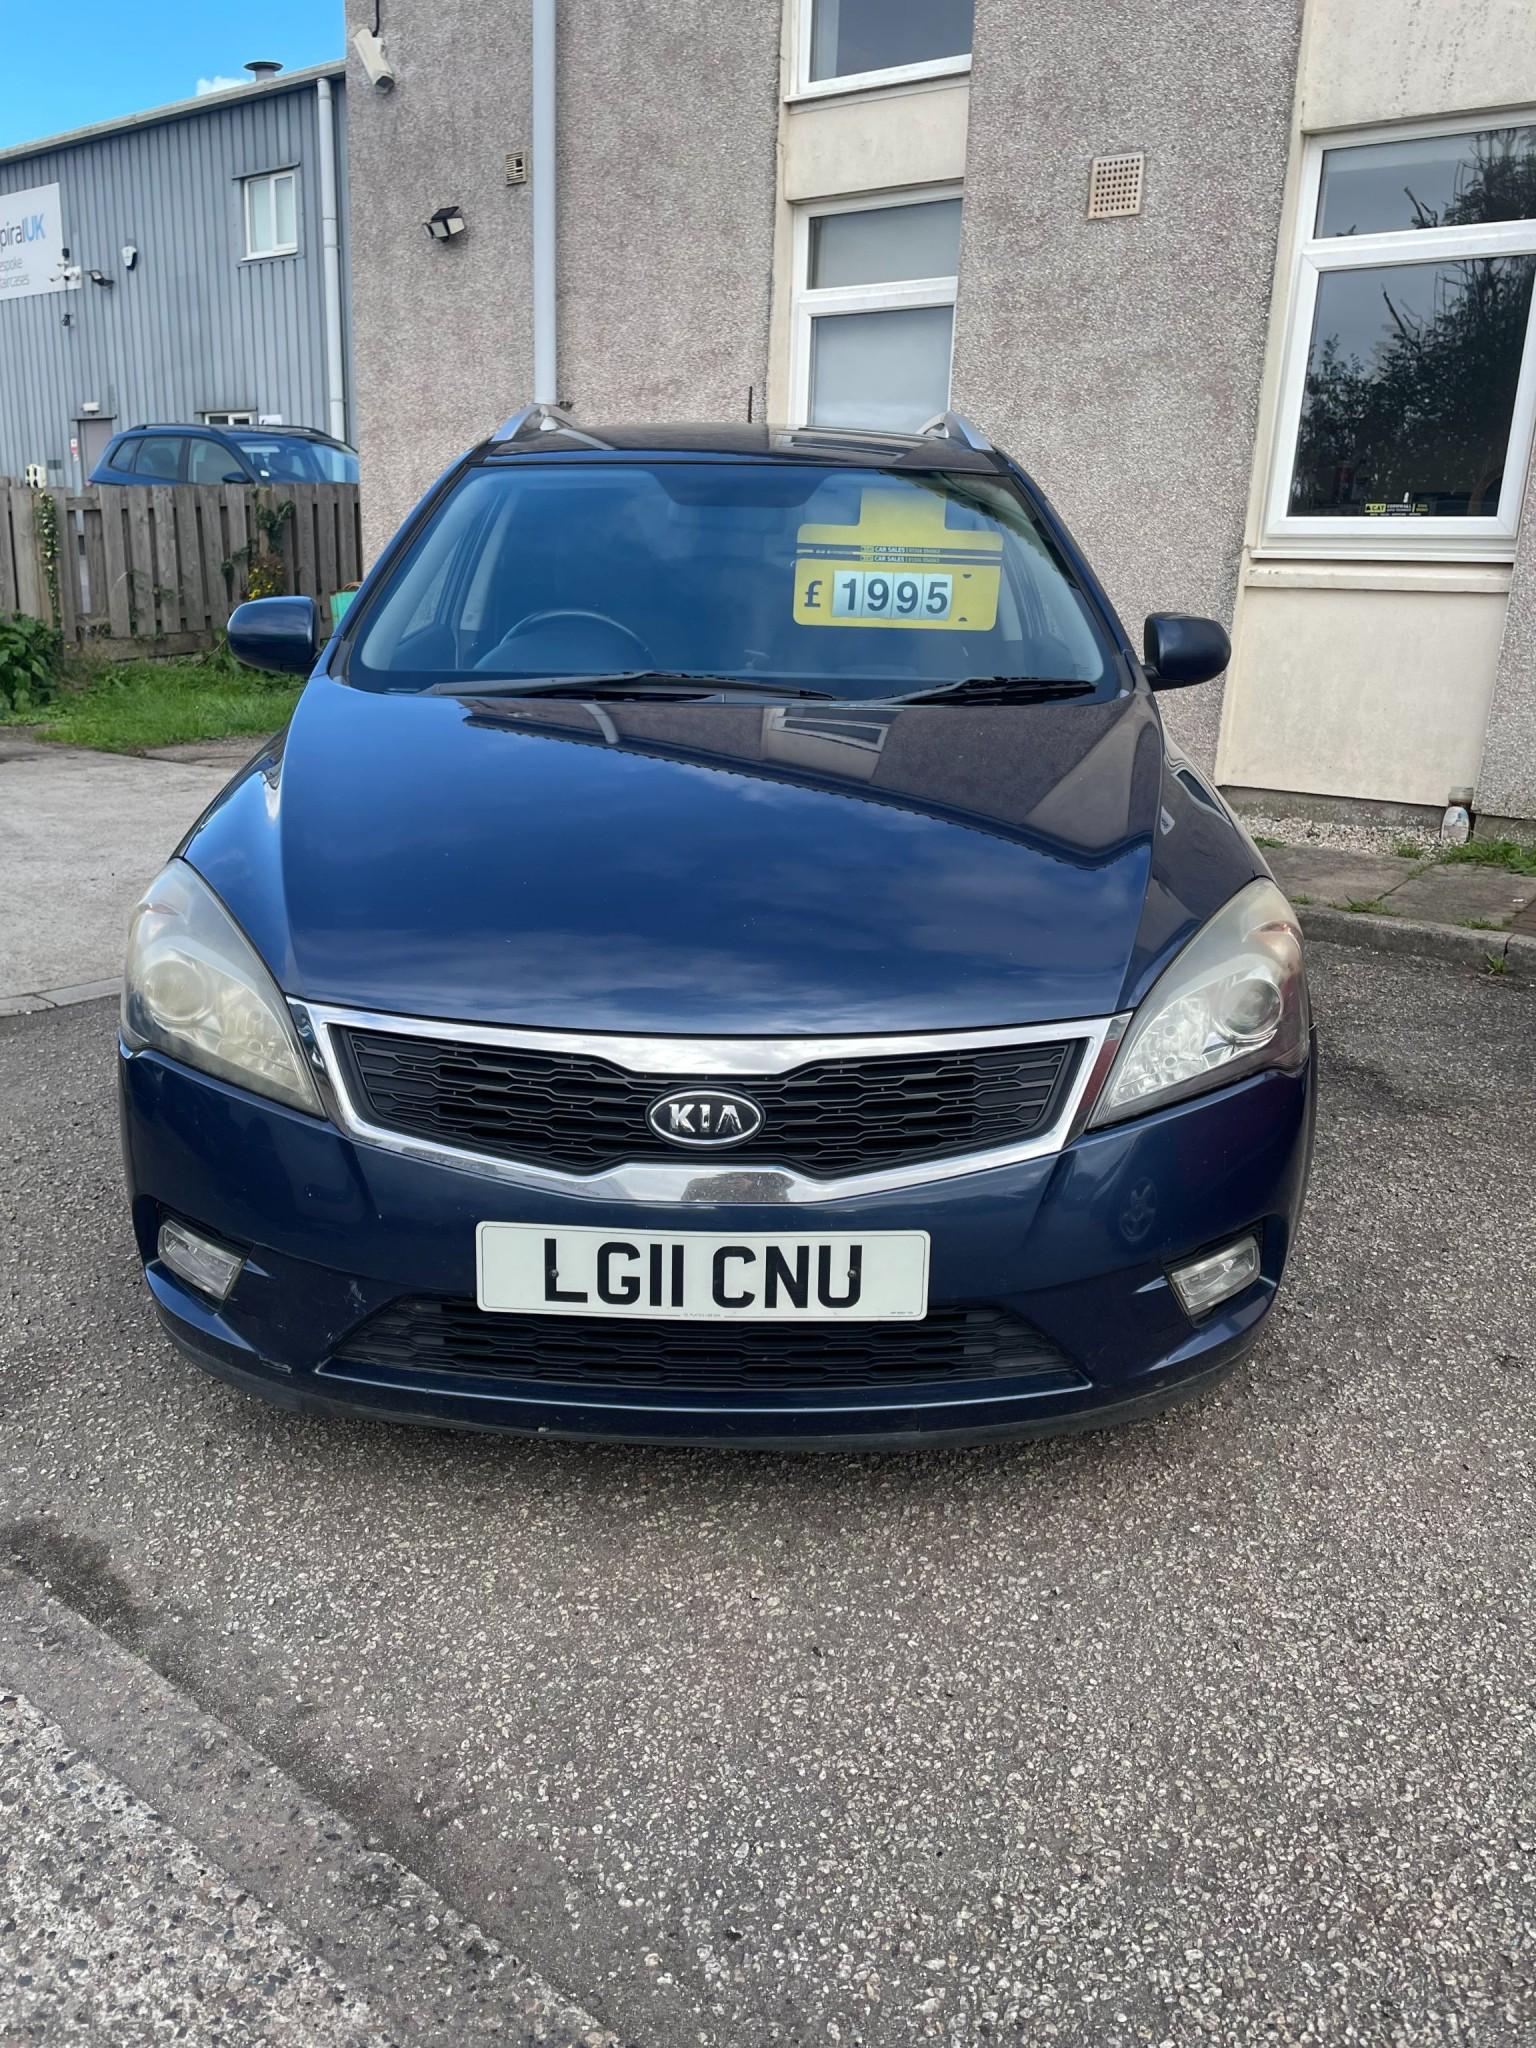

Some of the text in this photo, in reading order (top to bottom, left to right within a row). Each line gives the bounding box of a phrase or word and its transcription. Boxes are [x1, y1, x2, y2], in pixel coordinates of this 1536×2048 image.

[804, 577, 948, 614] £ 1995
[669, 1103, 742, 1133] KIA
[544, 1238, 863, 1309] LG11 CNU
